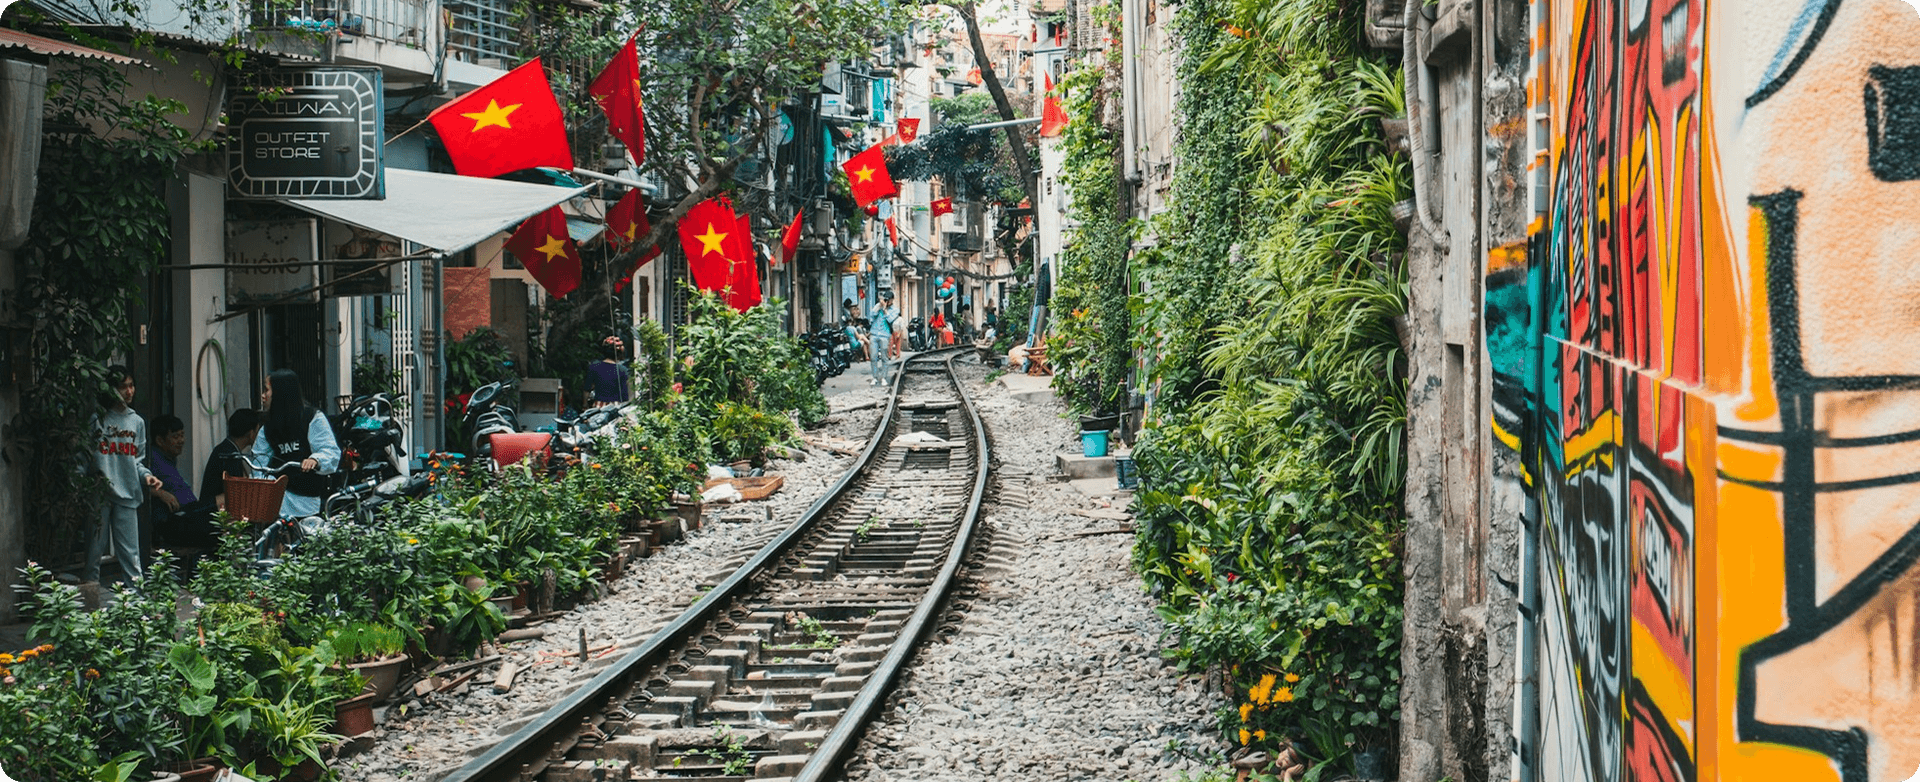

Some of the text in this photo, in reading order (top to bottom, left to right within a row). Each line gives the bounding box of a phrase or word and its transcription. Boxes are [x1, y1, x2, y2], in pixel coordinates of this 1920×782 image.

[230, 101, 358, 116] RAILWAY
[254, 132, 330, 144] OUTFIT
[255, 147, 321, 159] STORE
